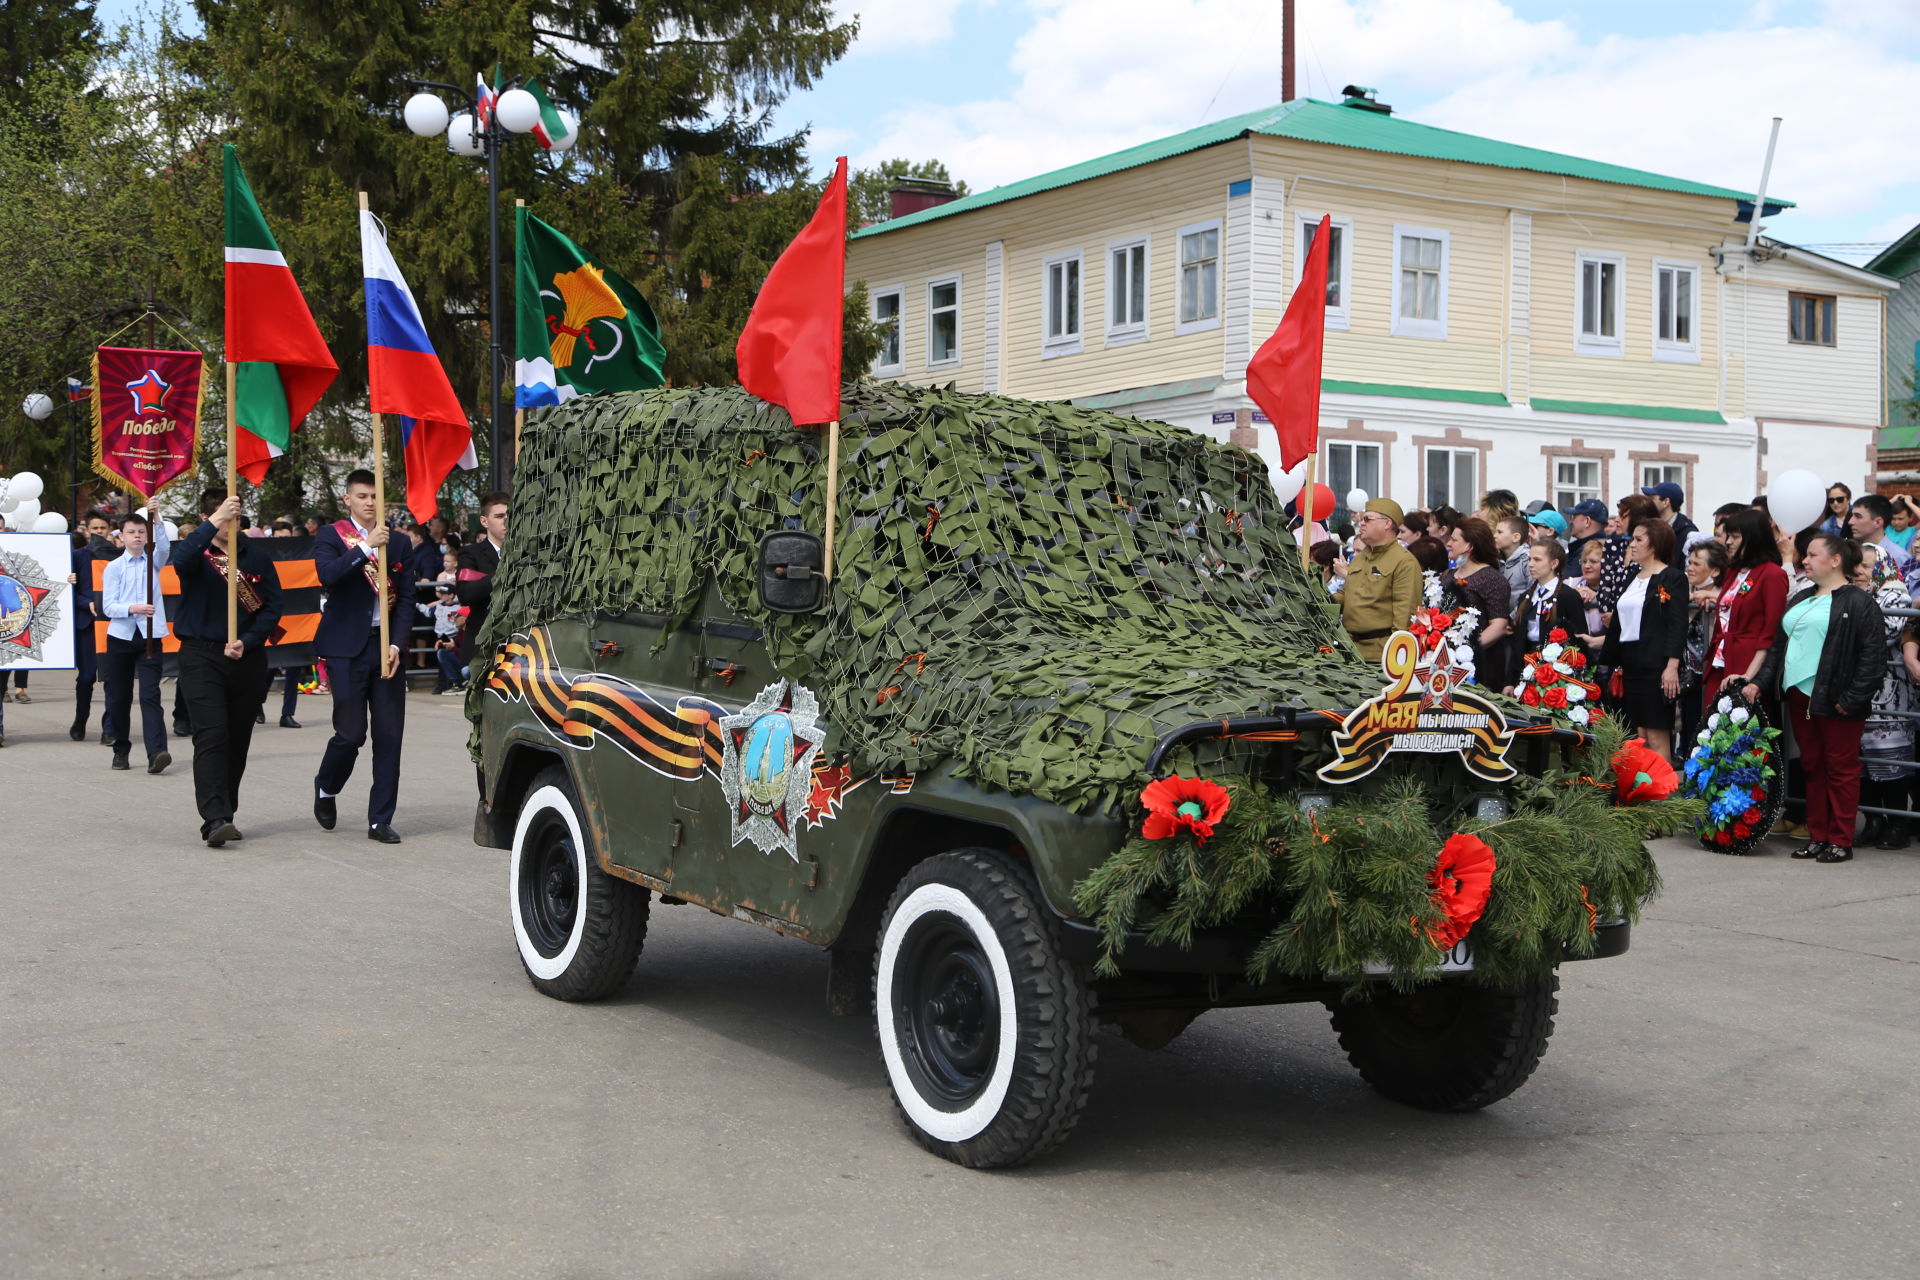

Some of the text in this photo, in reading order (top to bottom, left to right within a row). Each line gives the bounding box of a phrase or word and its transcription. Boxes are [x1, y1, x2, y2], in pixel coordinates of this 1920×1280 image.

[122, 417, 176, 435] Победа
[1385, 634, 1417, 701] 9
[1367, 702, 1419, 731] Мая
[1417, 713, 1489, 729] МЫ ПОМНИМ!
[1391, 734, 1475, 751] МЫ ГОРДИМСЯ!
[749, 797, 774, 815] ПОБЕДА
